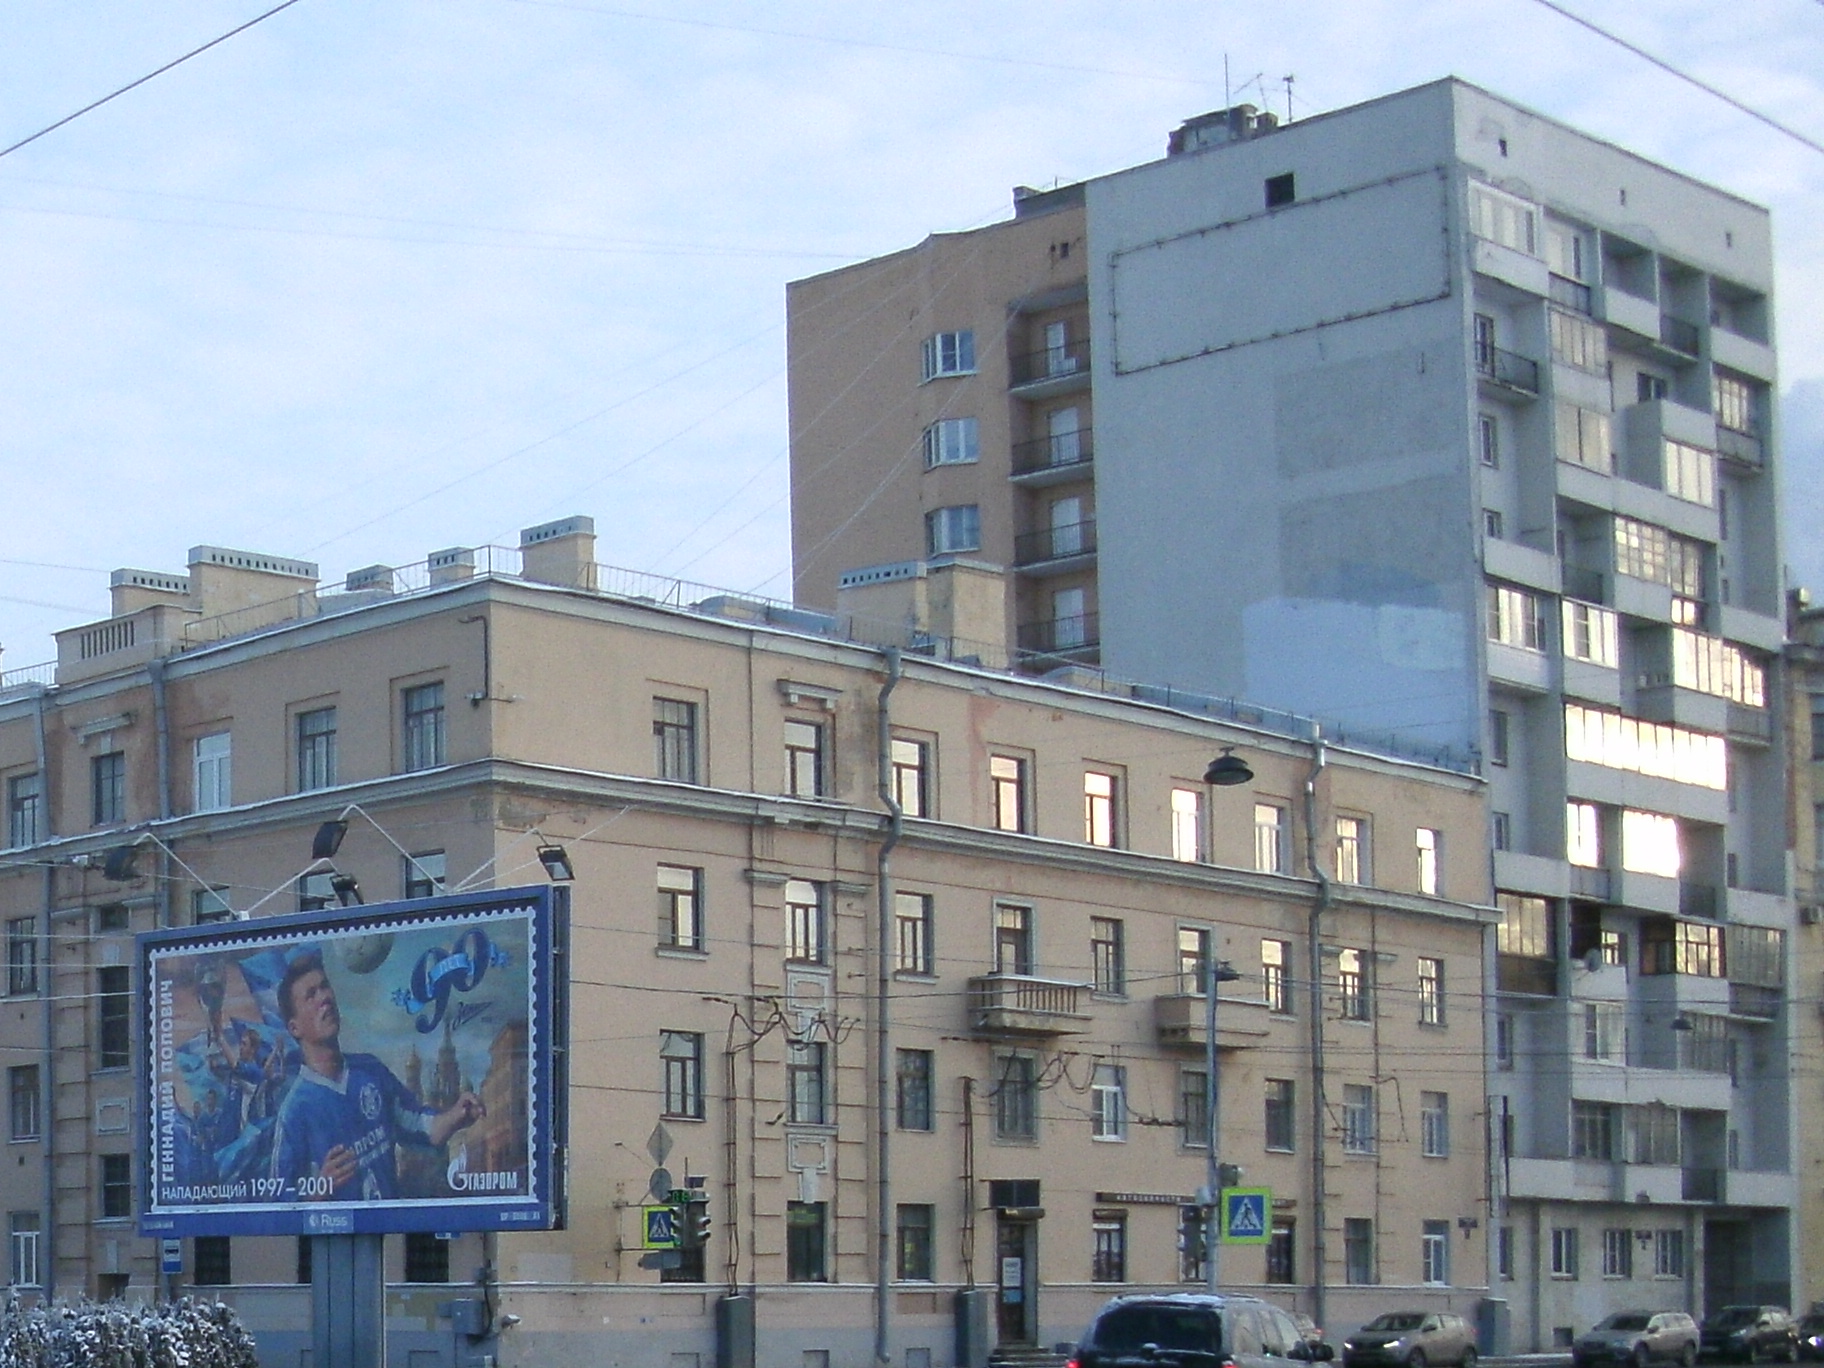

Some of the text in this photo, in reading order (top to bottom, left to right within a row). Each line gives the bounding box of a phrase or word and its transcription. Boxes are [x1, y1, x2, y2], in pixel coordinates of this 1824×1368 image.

[160, 979, 174, 1183] ГЕННАДИЙ ПОПОВИЧ
[350, 1126, 386, 1155] ПРОМ
[161, 1181, 247, 1202] НАПАДАЮЩИЙ
[468, 1172, 518, 1191] ГАЗПРОМ
